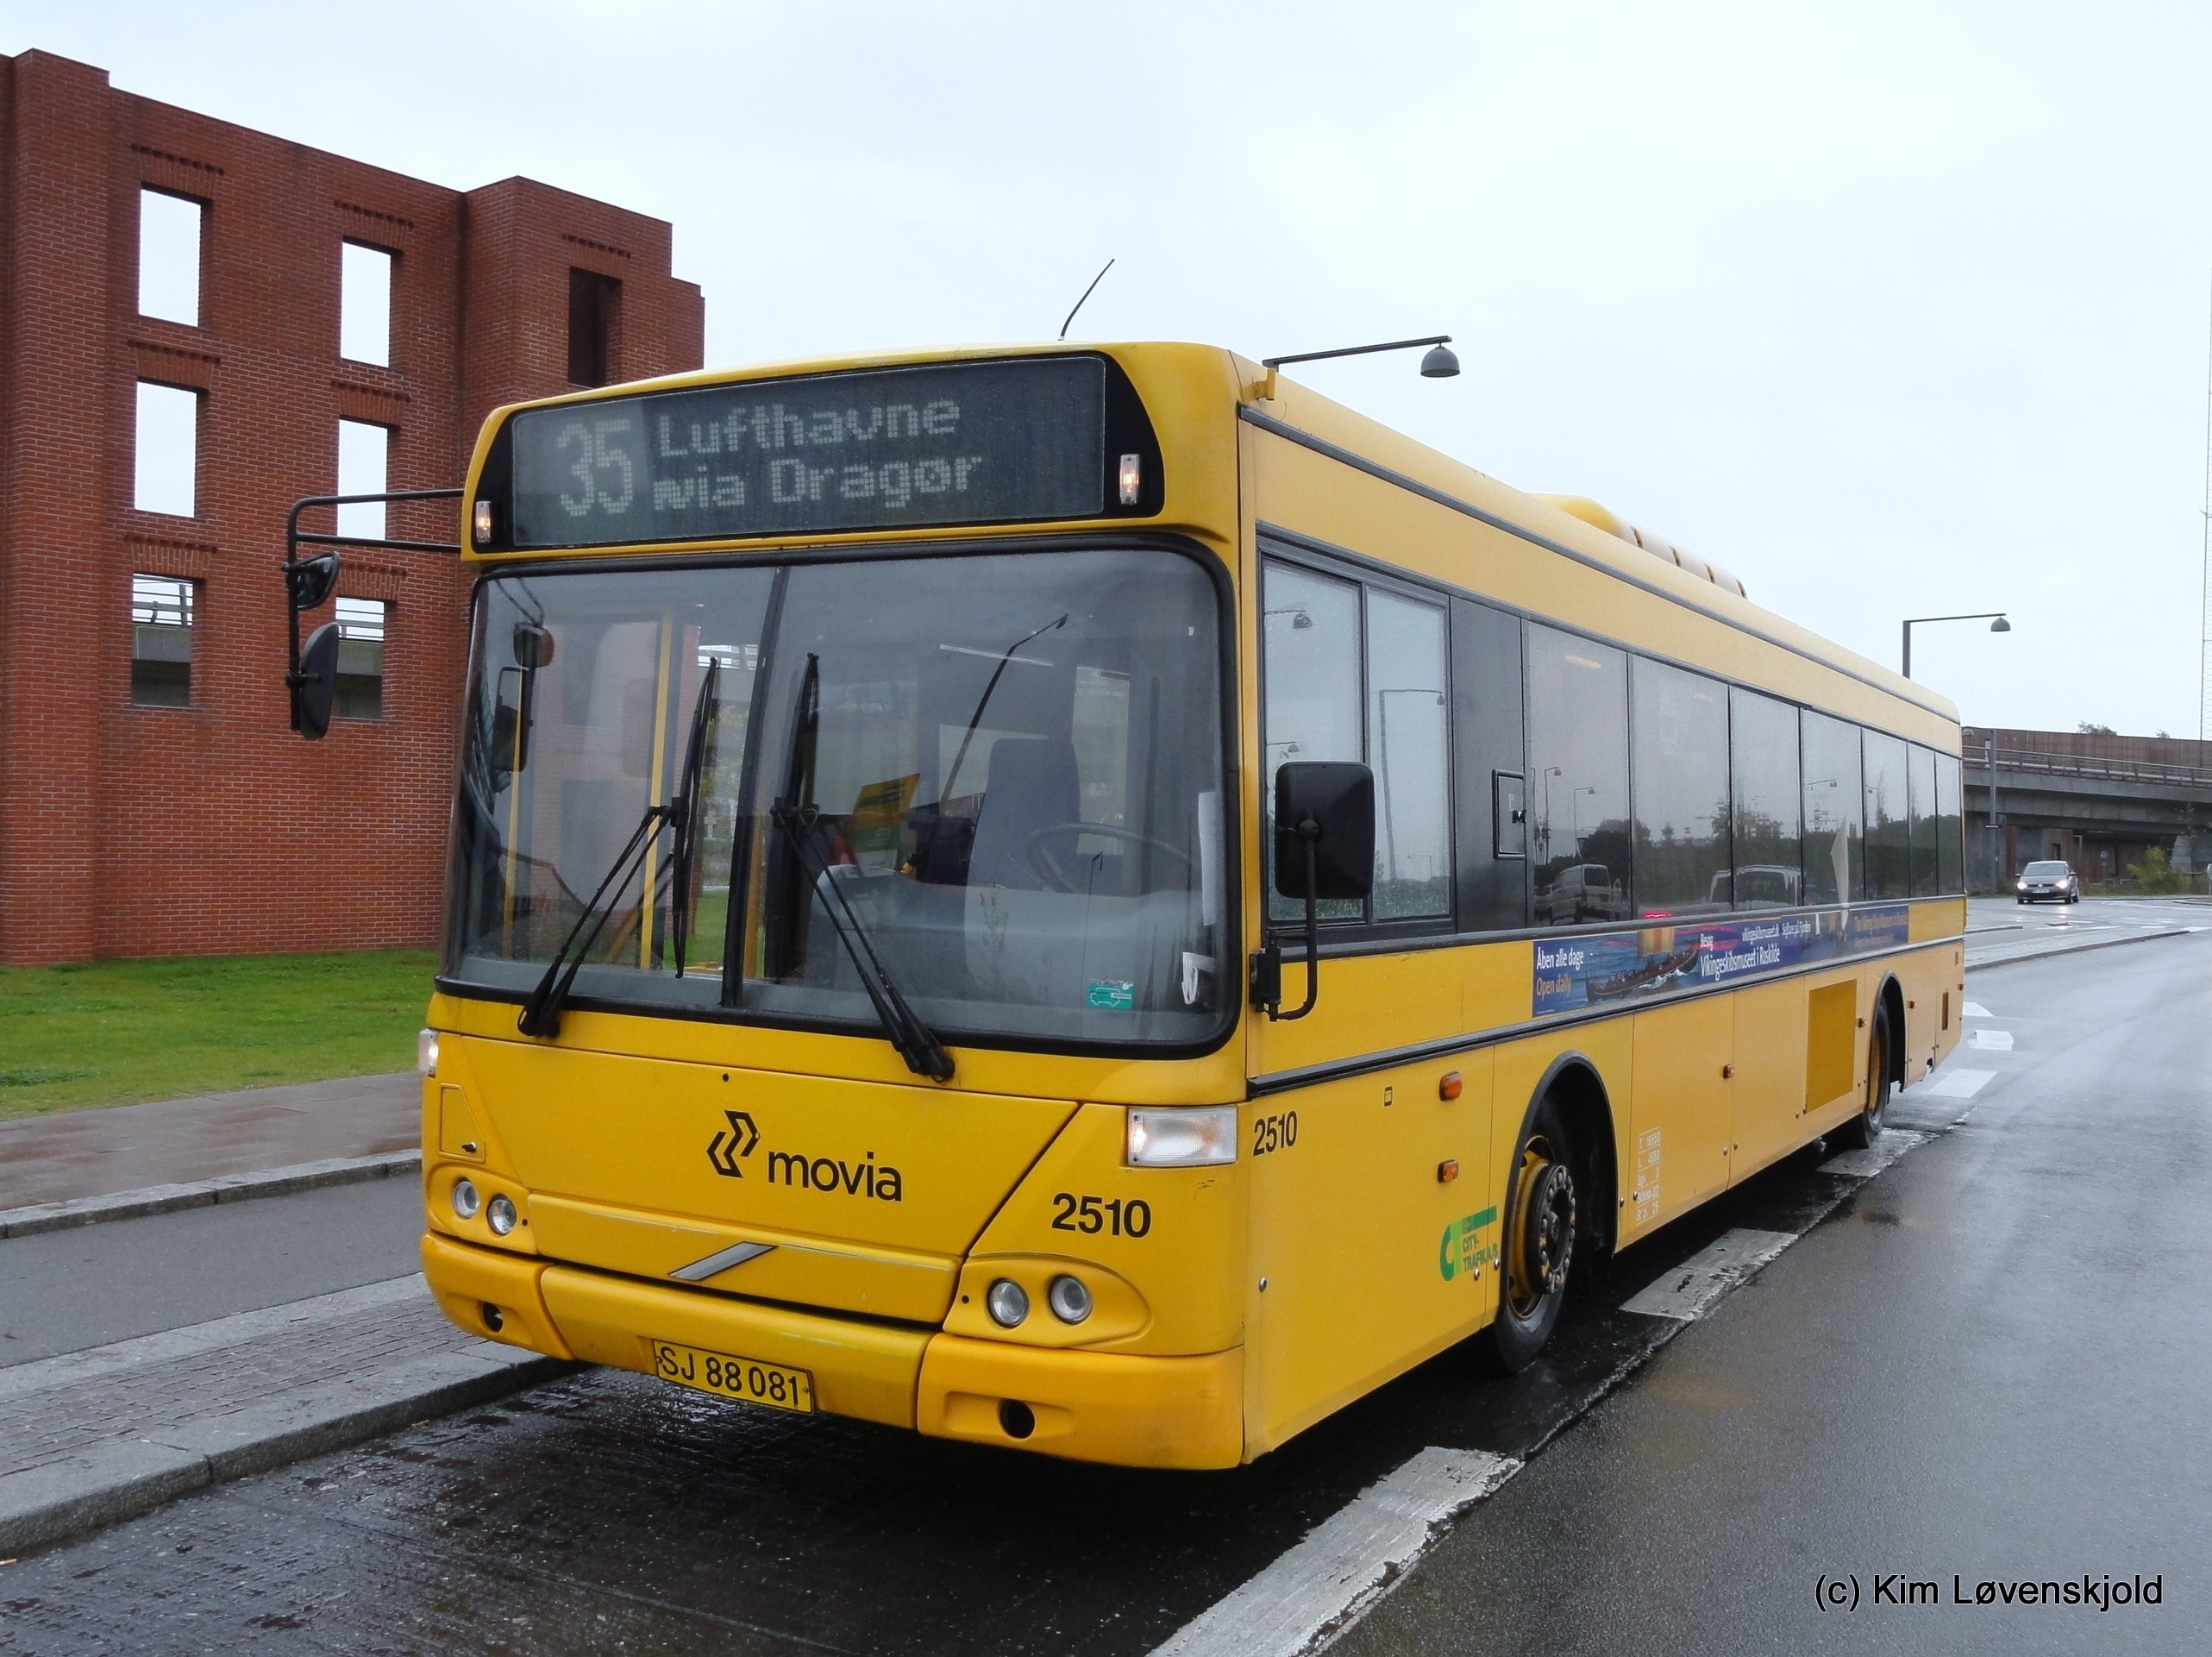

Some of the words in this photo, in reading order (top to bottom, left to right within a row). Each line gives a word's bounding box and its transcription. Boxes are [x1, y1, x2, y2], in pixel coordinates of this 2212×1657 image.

[660, 399, 960, 456] Lufthavne
[558, 417, 634, 516] 35
[771, 455, 983, 508] Dragør
[1536, 945, 1555, 970] Åben
[1555, 947, 1568, 968] alle
[1568, 946, 1584, 971] dage
[1700, 932, 1714, 951] Besøg
[1701, 947, 1756, 982] Vikingeskibsmuseet
[1756, 946, 1759, 966] i
[1759, 942, 1781, 965] Roskilde
[1536, 976, 1555, 1001] Open
[1556, 972, 1572, 998] daily
[1253, 1110, 1298, 1156] 2510
[768, 1151, 903, 1202] movia
[1051, 1191, 1152, 1239] 2510
[660, 1346, 696, 1381] SJ
[705, 1357, 743, 1393] 88
[748, 1365, 799, 1405] 081
